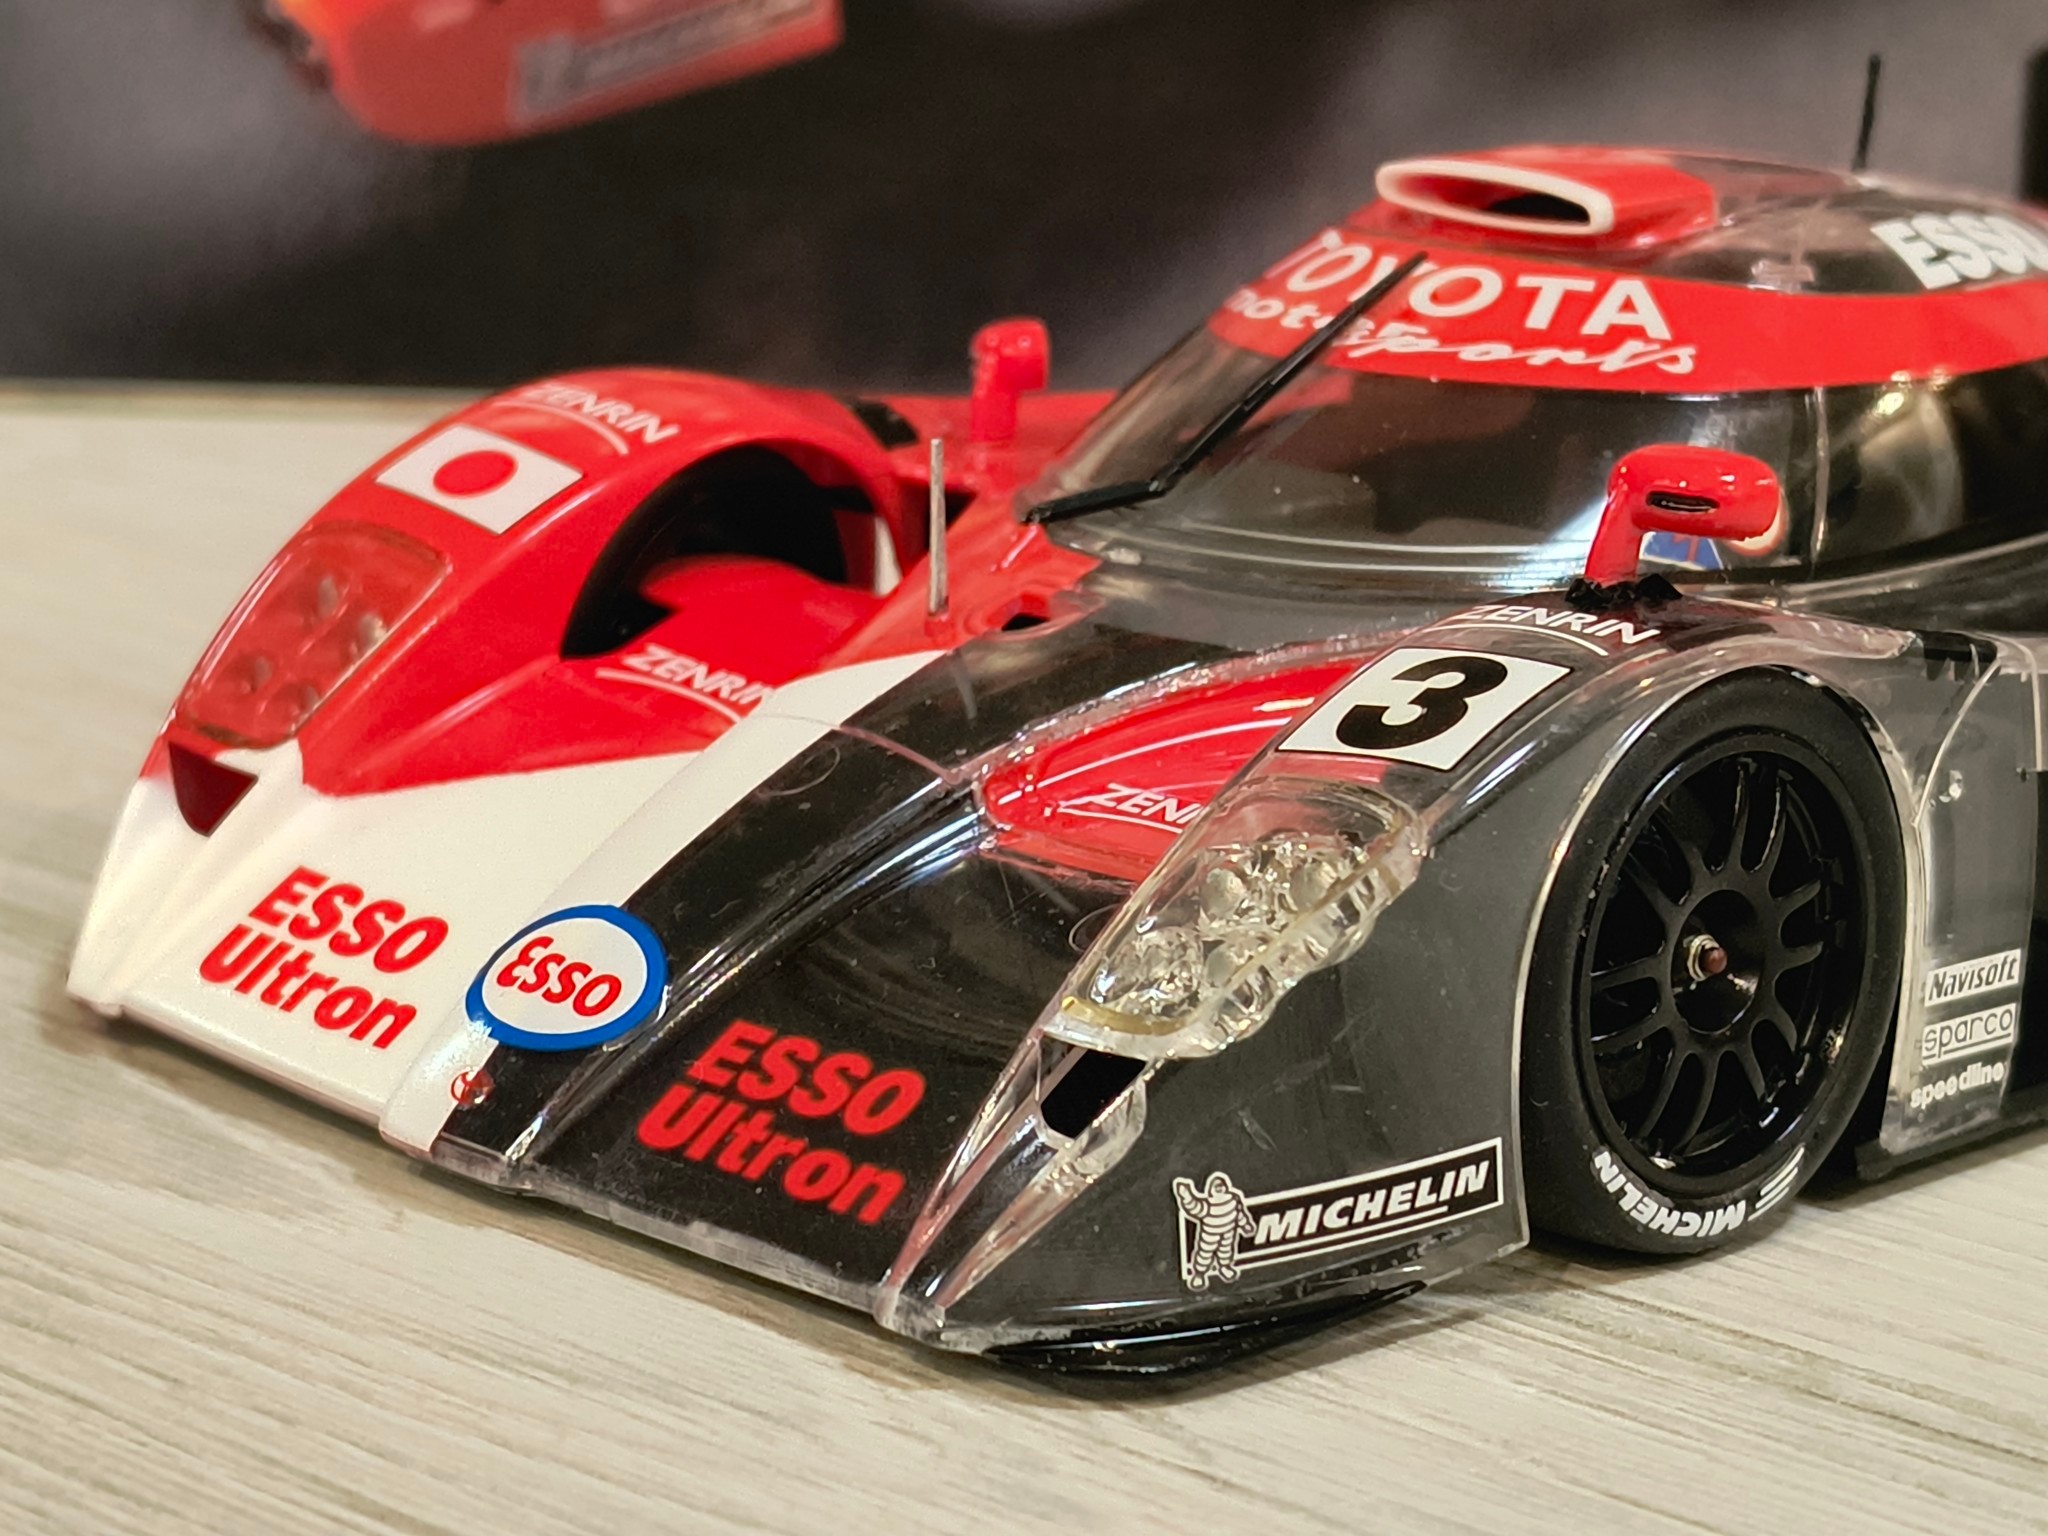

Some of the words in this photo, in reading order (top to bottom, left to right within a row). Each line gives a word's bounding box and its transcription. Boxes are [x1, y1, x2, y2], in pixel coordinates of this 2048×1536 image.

[520, 383, 681, 443] ZENRIN
[1450, 604, 1661, 645] ZENRIN
[1336, 655, 1508, 749] 3
[247, 866, 450, 974] ESSO
[199, 924, 418, 1050] Ultron
[1928, 955, 2018, 1001] Navisoft
[686, 1018, 927, 1136] ESSO
[1924, 1009, 2013, 1059] sparco
[1910, 1061, 2006, 1110] speedline
[636, 1083, 907, 1227] Ultron
[1593, 1151, 1747, 1237] MICHELIN
[1253, 1160, 1490, 1246] MICHELIN
